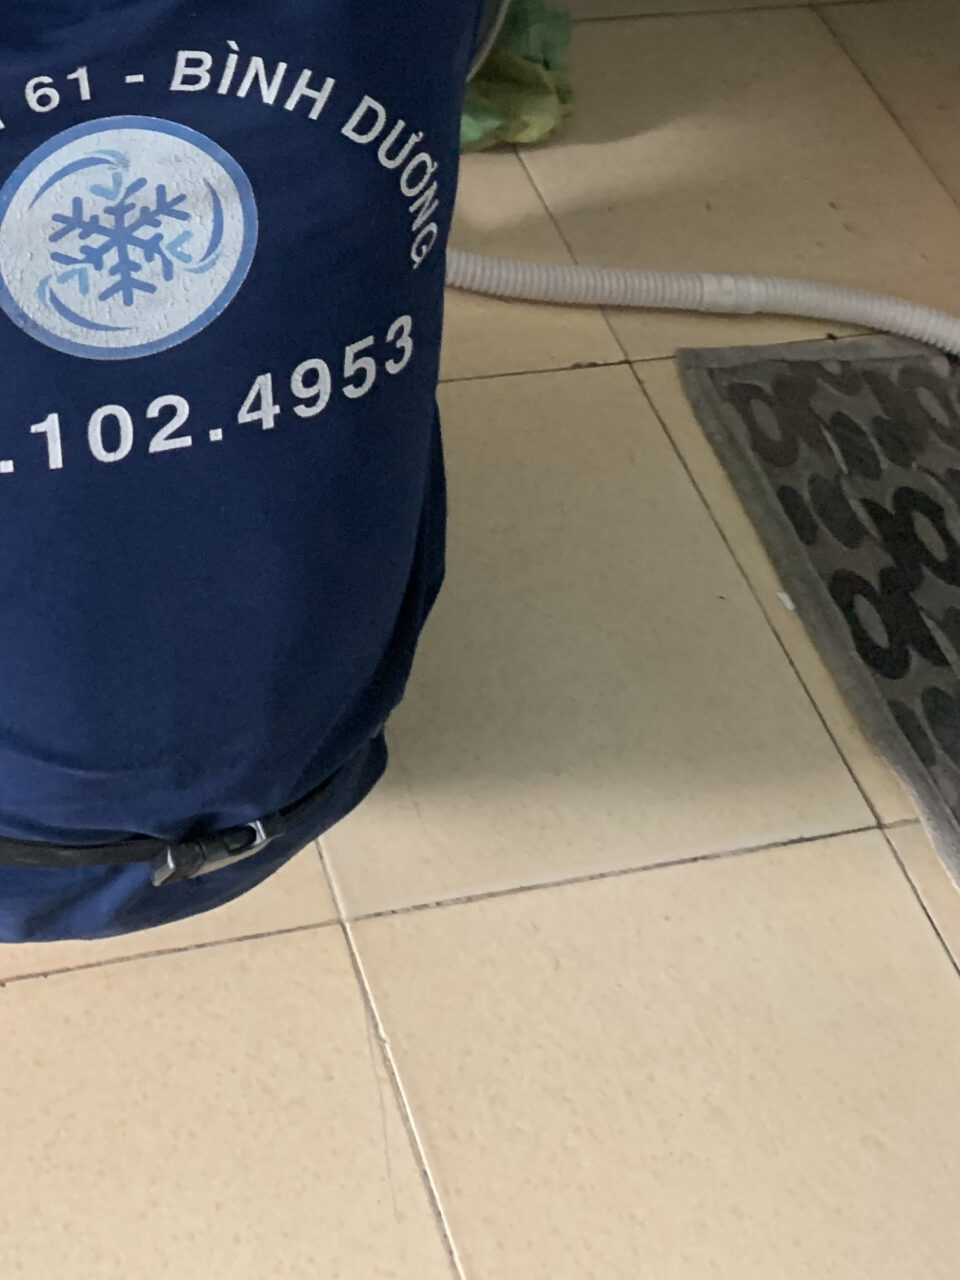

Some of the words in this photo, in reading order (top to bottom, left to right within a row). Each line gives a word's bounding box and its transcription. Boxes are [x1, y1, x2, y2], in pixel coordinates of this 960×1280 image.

[25, 66, 92, 113] 61
[170, 41, 335, 120] BÌNH
[341, 95, 439, 269] DƯƠNG
